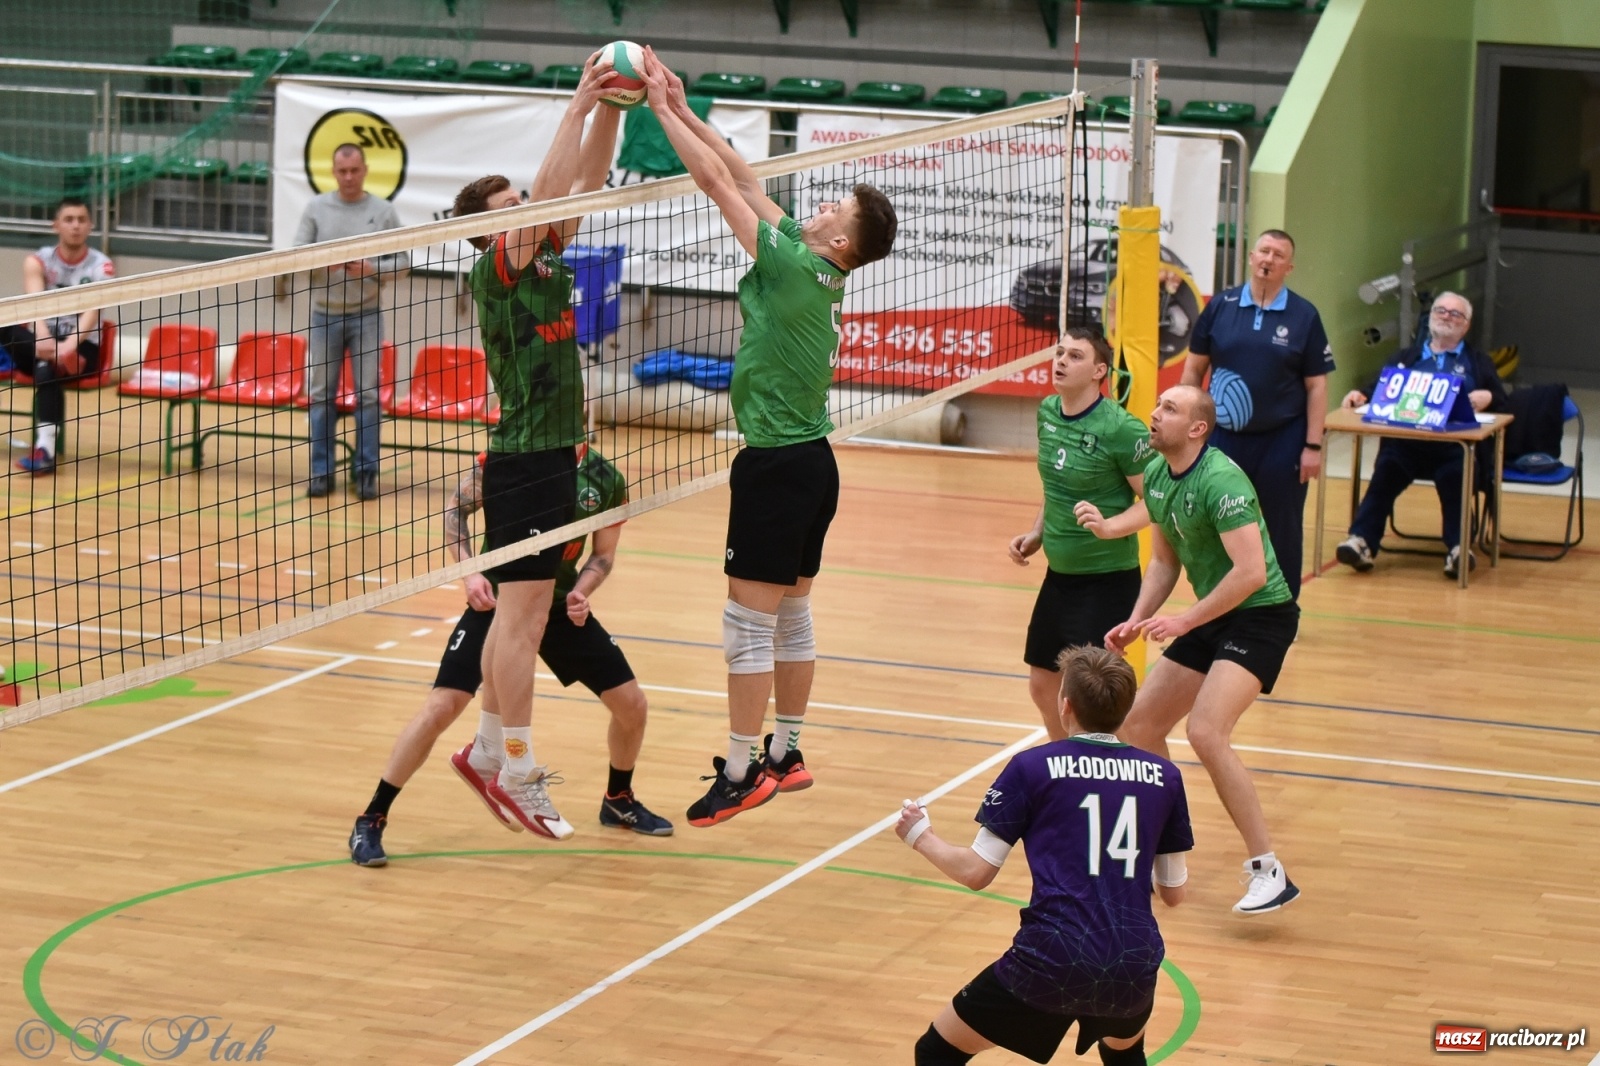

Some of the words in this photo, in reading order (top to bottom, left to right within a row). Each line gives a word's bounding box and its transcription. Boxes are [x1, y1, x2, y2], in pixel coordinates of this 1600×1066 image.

[841, 321, 880, 348] 95
[885, 325, 936, 354] 496
[940, 329, 994, 358] 555
[1026, 369, 1049, 385] 45
[1386, 373, 1404, 399] 9
[1427, 378, 1450, 404] 10
[450, 630, 466, 651] 3
[1046, 755, 1164, 787] WŁODOWICE
[1078, 792, 1141, 879] 14
